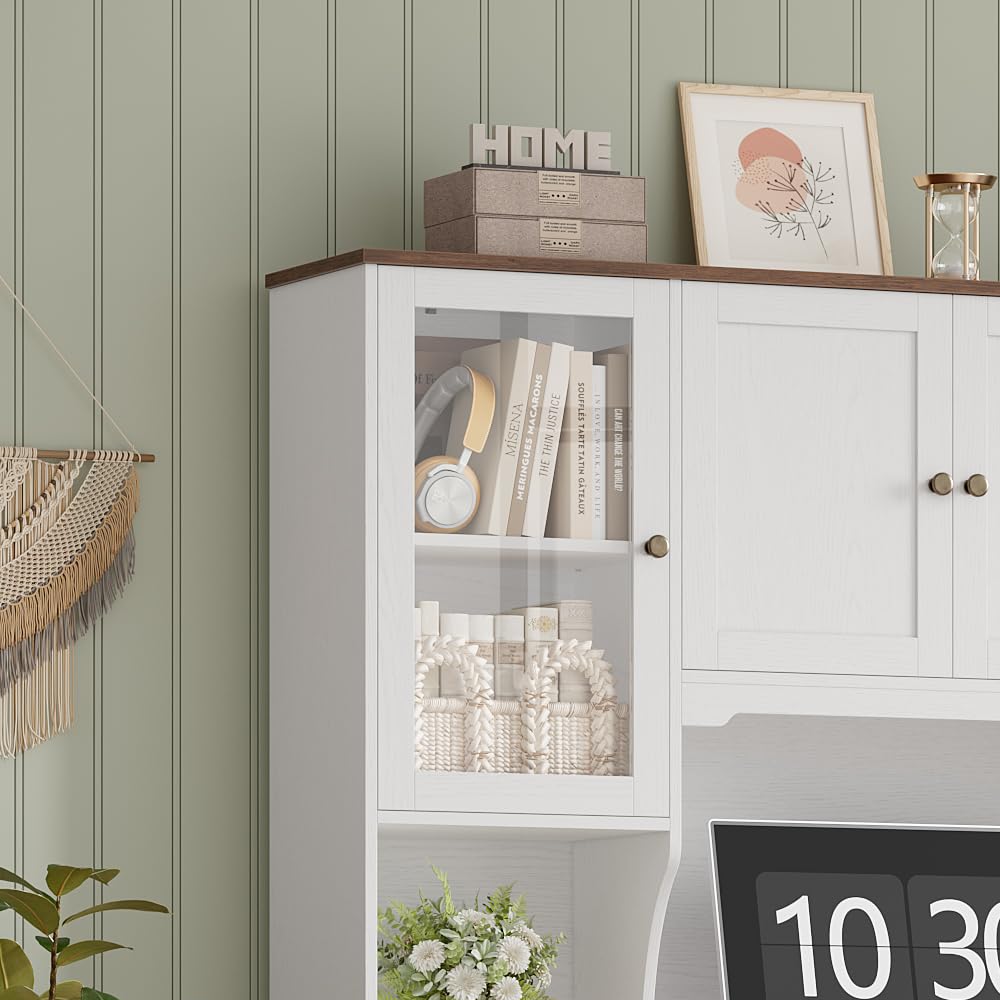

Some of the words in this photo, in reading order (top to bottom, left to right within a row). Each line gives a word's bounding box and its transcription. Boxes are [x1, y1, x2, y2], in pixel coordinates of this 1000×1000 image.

[470, 123, 611, 170] HOME
[545, 391, 561, 431] JUSTICE
[516, 437, 533, 501] MERINGUES
[527, 373, 543, 435] MACARONS
[542, 433, 554, 456] THIN
[577, 423, 585, 449] TARTE
[538, 459, 550, 477] THE
[577, 450, 585, 475] TATIN
[775, 895, 891, 1000] 10
